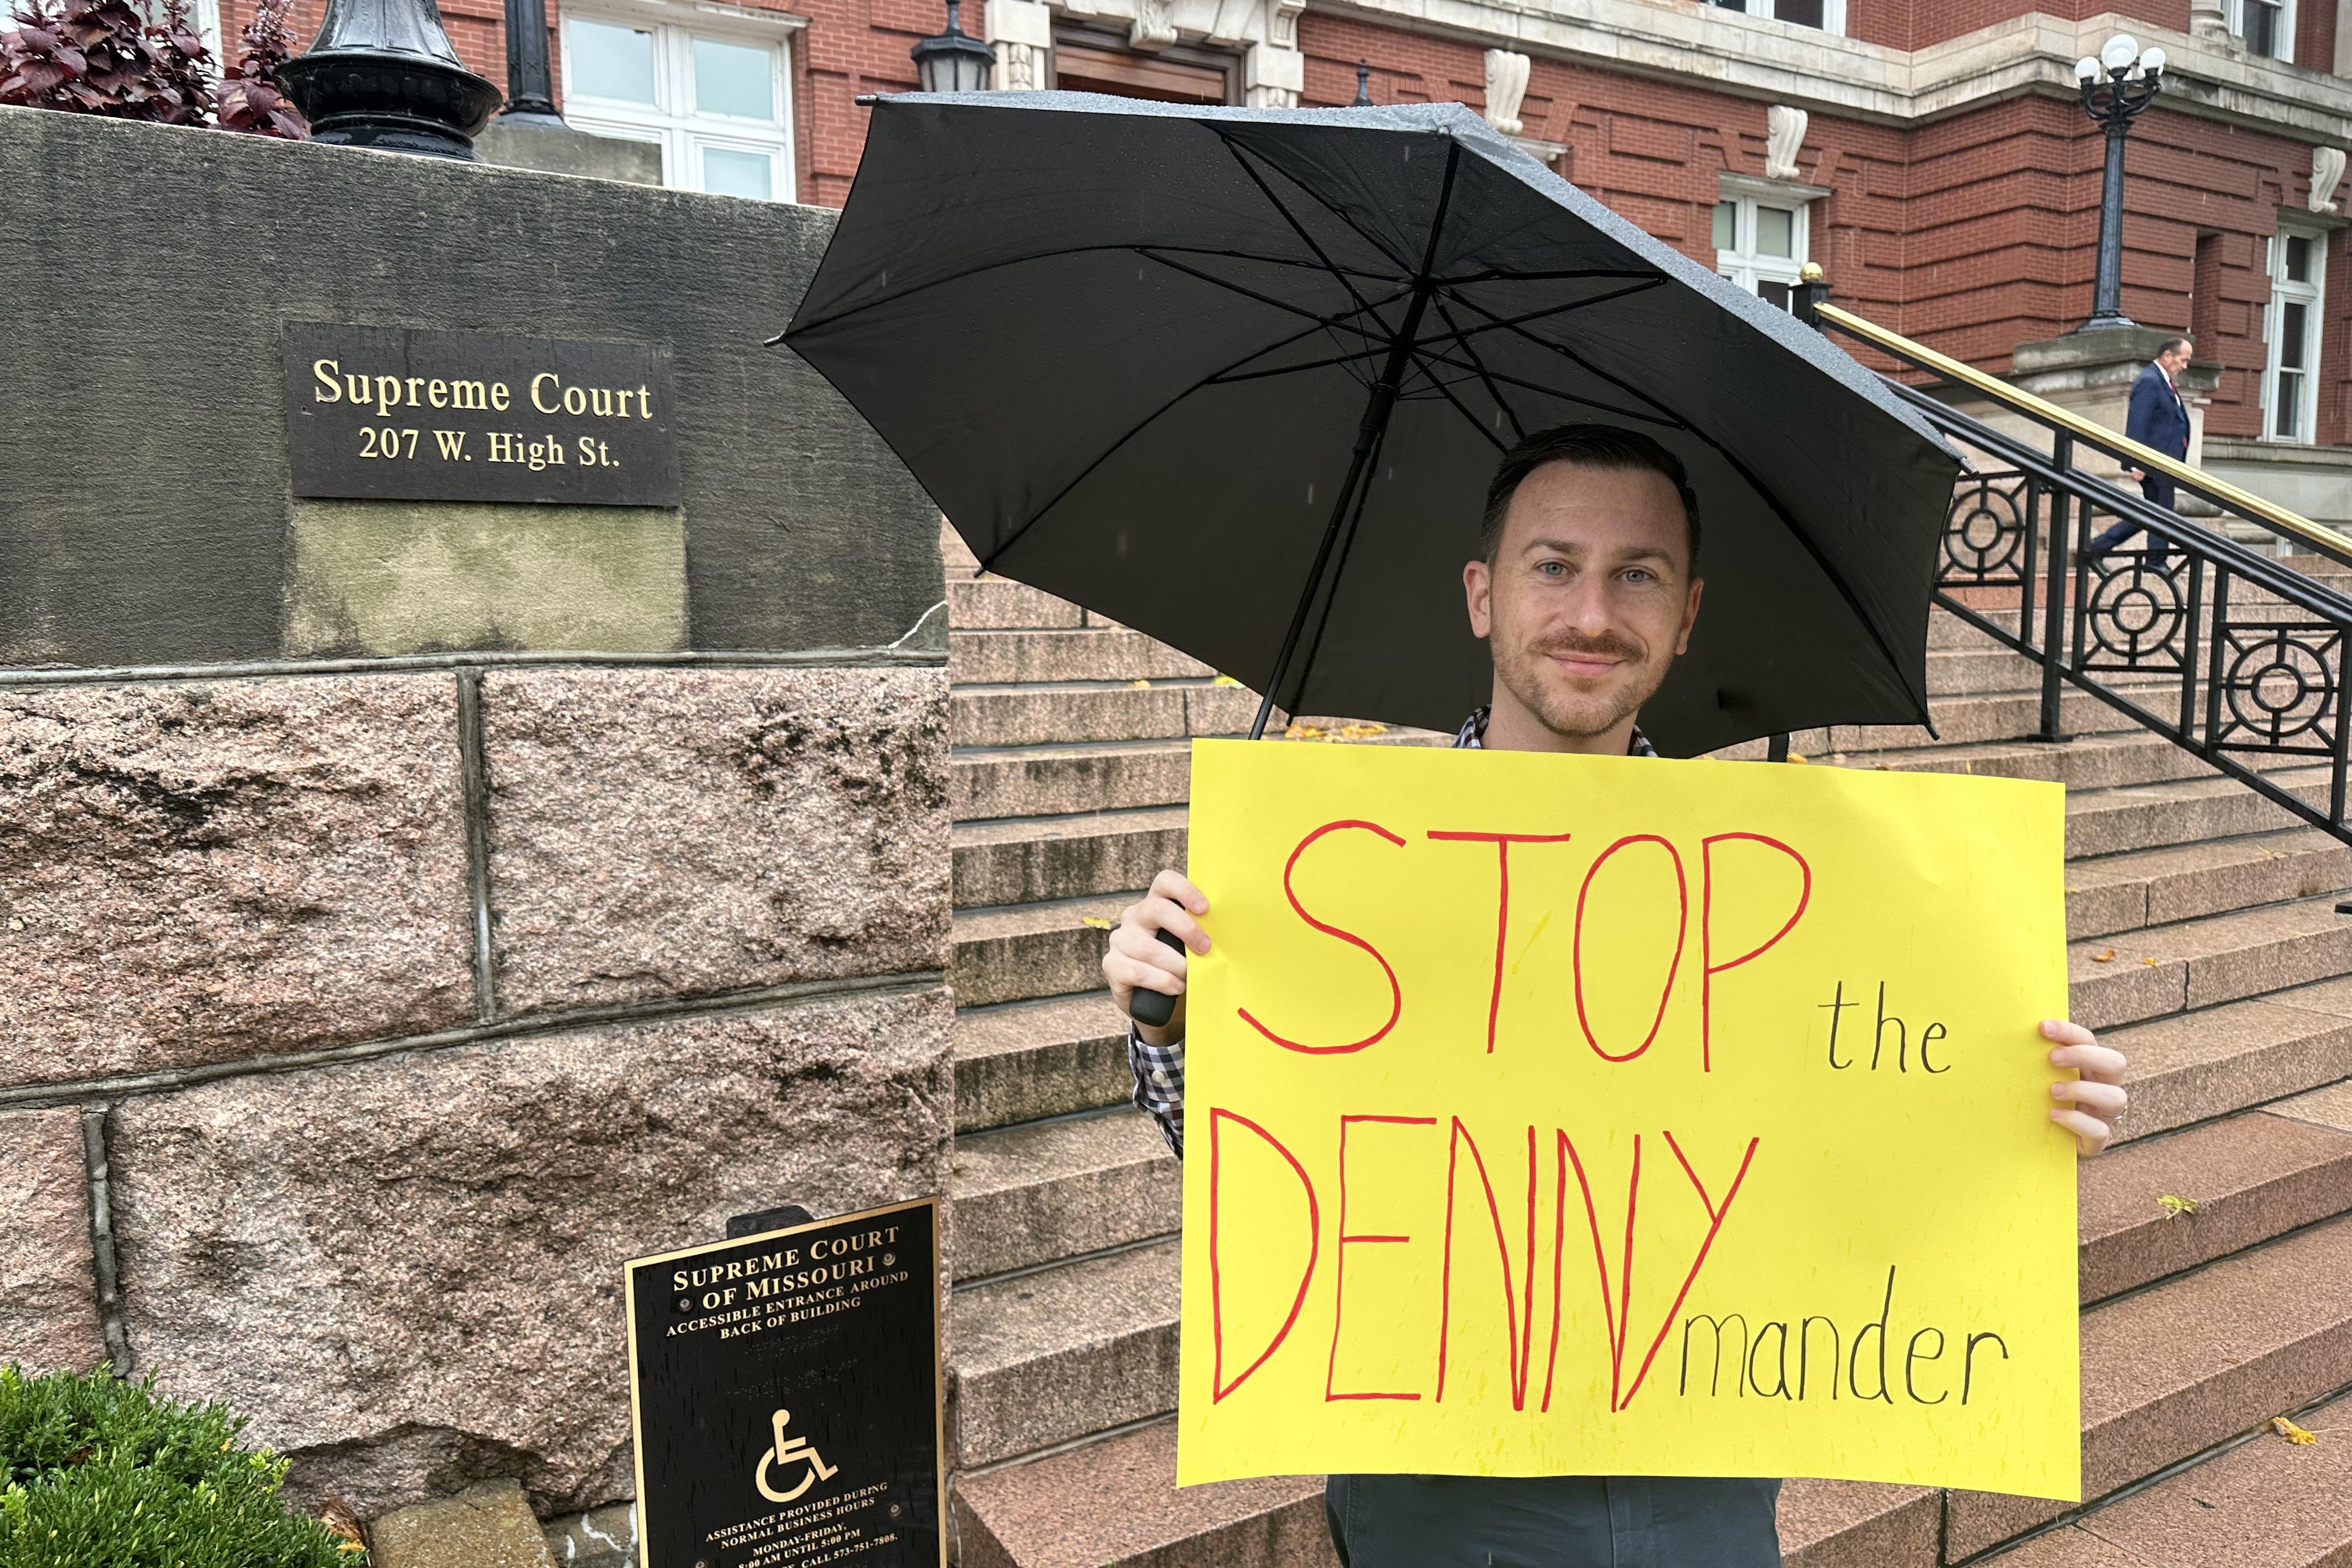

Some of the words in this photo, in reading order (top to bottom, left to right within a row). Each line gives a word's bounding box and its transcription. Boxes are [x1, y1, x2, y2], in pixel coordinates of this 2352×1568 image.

[313, 359, 510, 416] Supreme
[531, 373, 653, 419] Court
[359, 428, 418, 460] 207
[432, 430, 472, 462] W.
[488, 432, 565, 471] High
[579, 437, 620, 467] St.
[1237, 819, 1812, 1072] STOP
[1818, 980, 1951, 1073] the
[674, 1249, 800, 1292] SUPREME
[810, 1226, 899, 1260] COURT
[702, 1287, 737, 1310] OF
[746, 1256, 874, 1301] MISSOURI
[666, 1306, 761, 1337] ACCESSIBLE
[766, 1286, 845, 1313] ENTRANCE
[850, 1271, 908, 1293] AROUND
[720, 1320, 762, 1339] BACK
[766, 1314, 786, 1328] OF
[790, 1297, 861, 1322] BUILDING
[705, 1515, 776, 1542] ASSISTANCE
[779, 1496, 840, 1521] PROVIDED
[844, 1482, 887, 1502] DURING
[720, 1527, 774, 1549] NORMAL
[777, 1510, 832, 1532] BUSINESS
[836, 1497, 875, 1515] HOURS
[762, 1553, 780, 1565] AM
[784, 1542, 818, 1559] UNTIL
[821, 1534, 842, 1548] 5:00
[845, 1528, 860, 1541] PM
[802, 1553, 831, 1568] CALL
